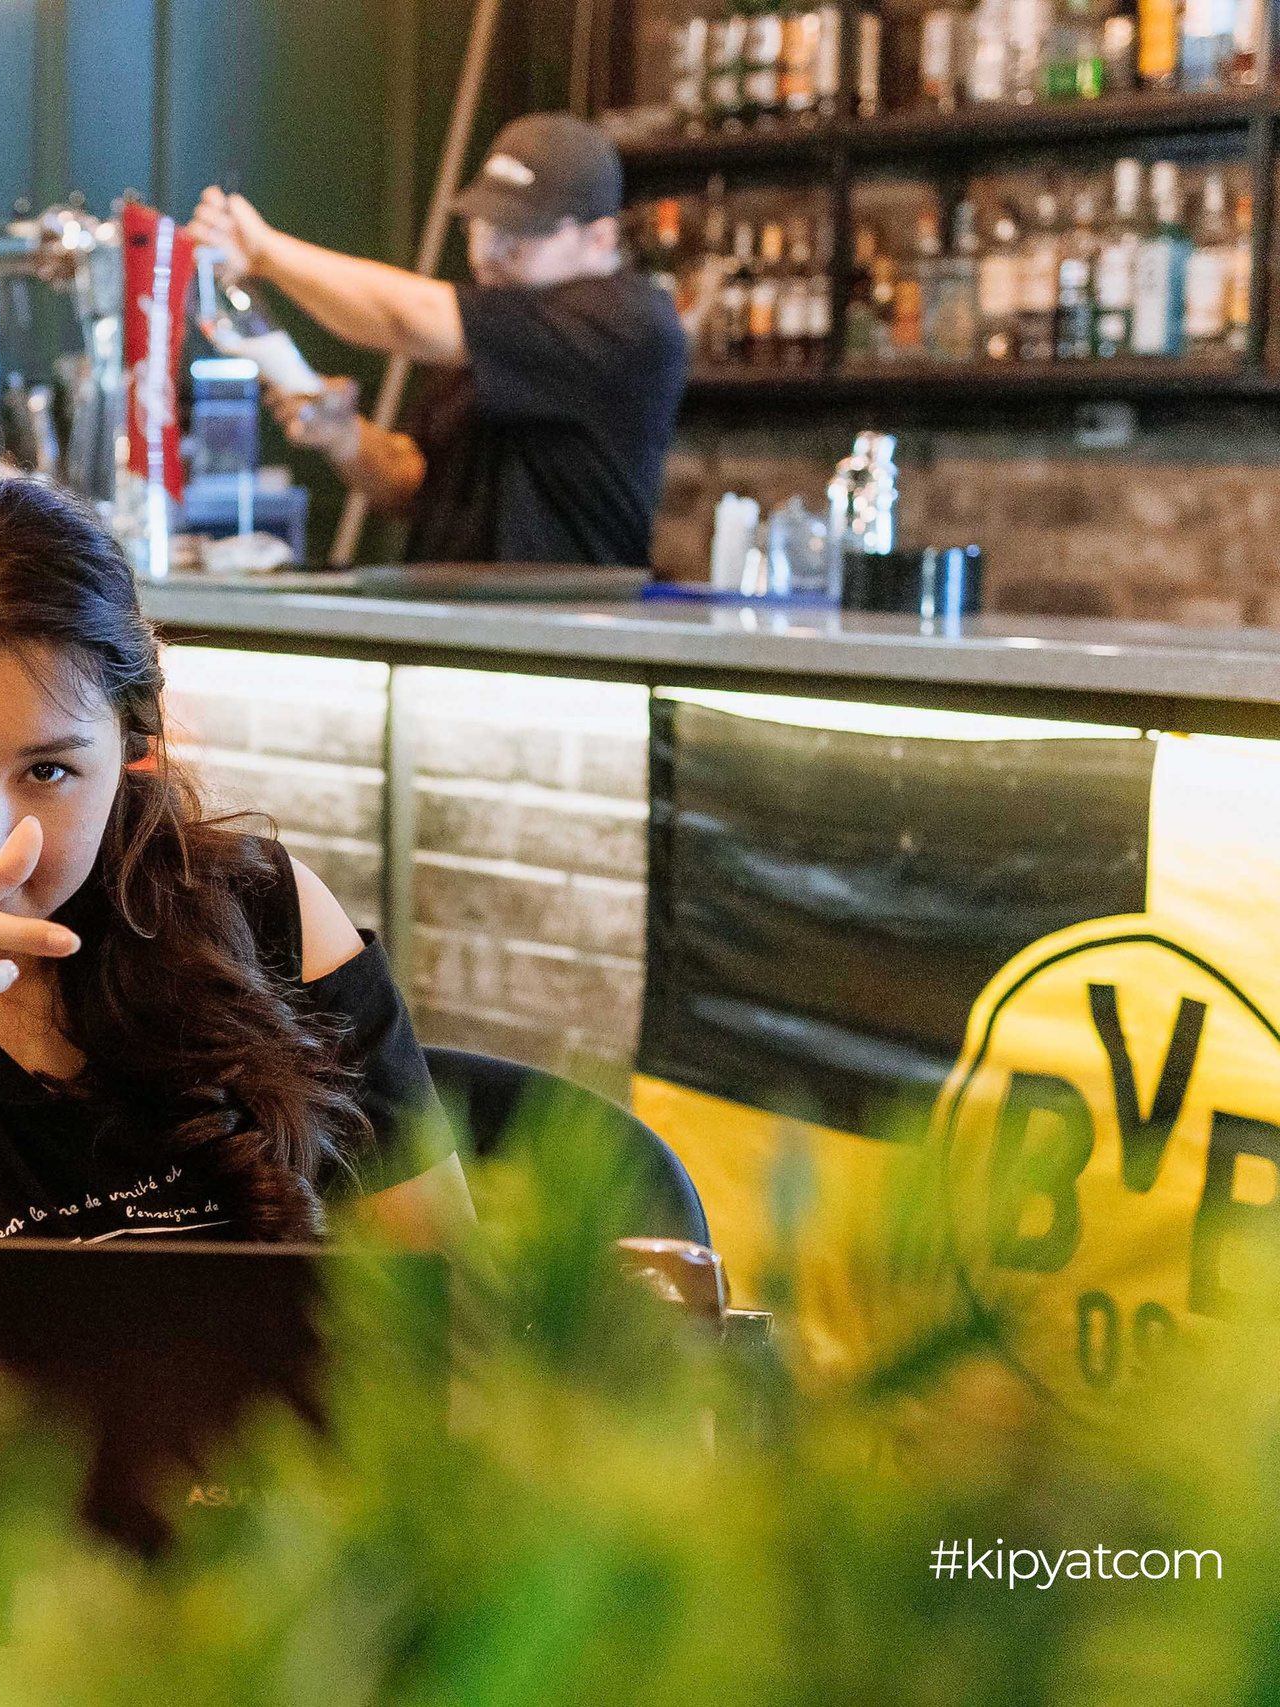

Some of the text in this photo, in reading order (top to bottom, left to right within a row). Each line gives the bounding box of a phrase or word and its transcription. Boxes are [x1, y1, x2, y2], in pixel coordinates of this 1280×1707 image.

[29, 1205, 48, 1222] la
[85, 1193, 103, 1210] de
[165, 1165, 183, 1183] et
[204, 1199, 219, 1213] de
